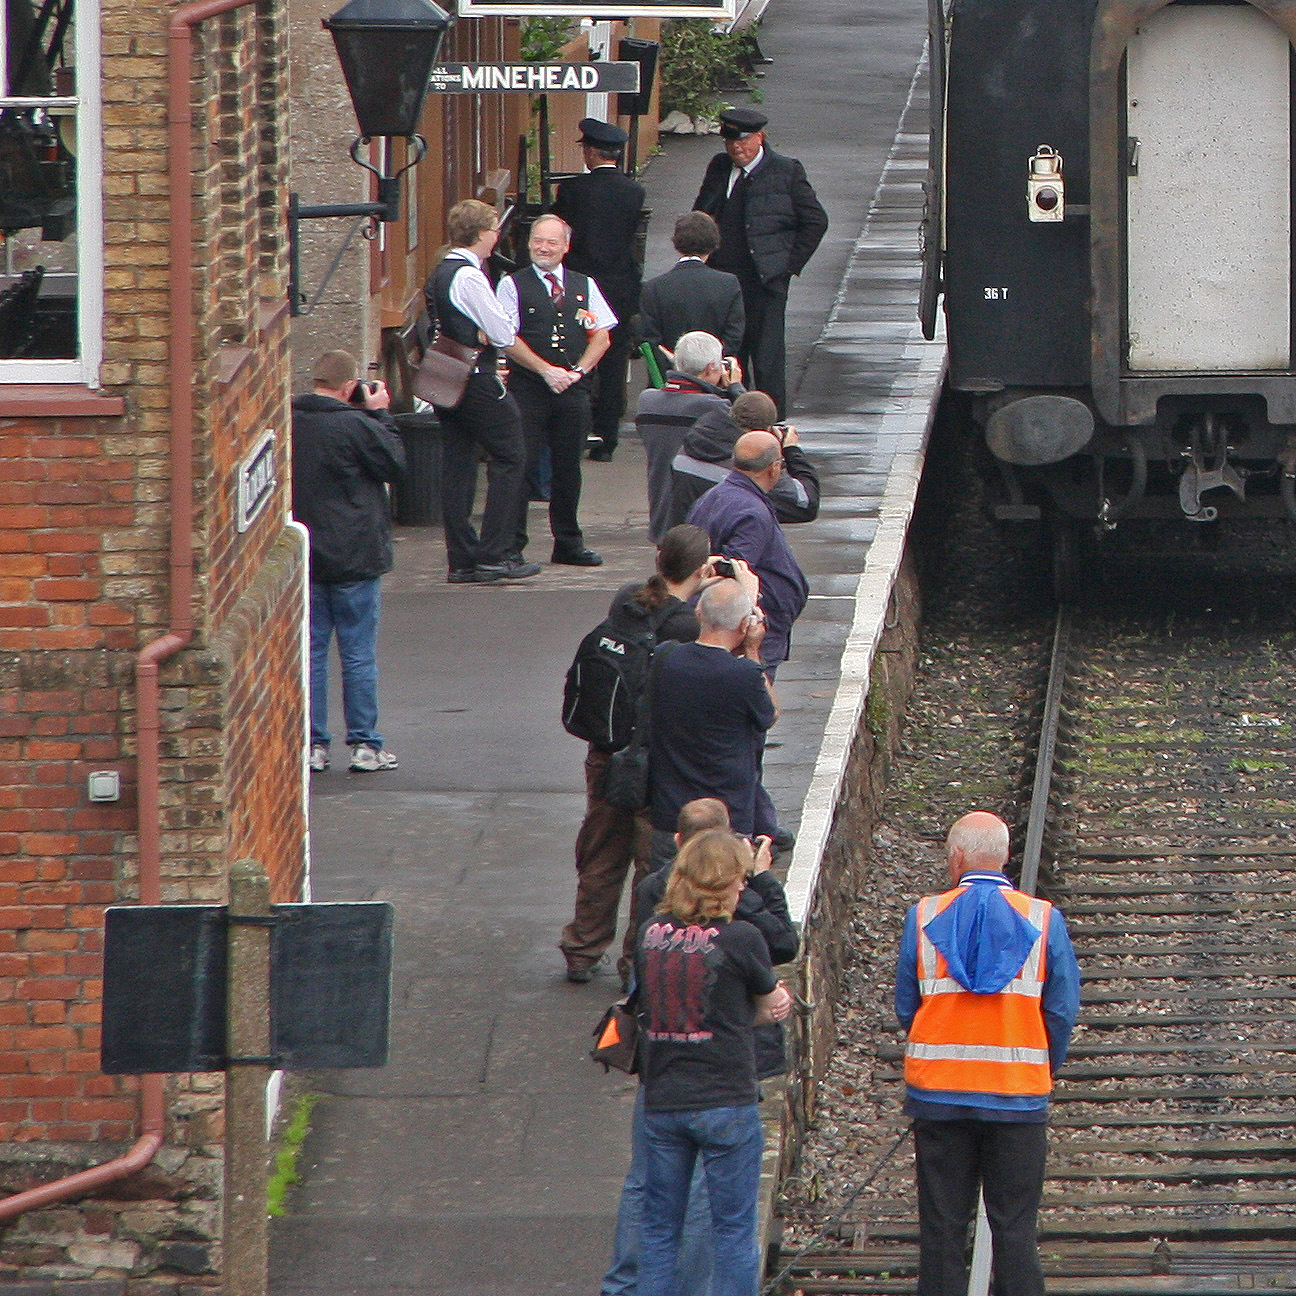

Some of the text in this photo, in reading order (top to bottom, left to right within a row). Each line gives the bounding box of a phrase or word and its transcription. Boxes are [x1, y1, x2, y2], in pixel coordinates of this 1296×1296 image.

[462, 65, 600, 90] MINEHEAD
[984, 287, 999, 300] 36
[599, 636, 626, 655] FILA
[643, 922, 720, 954] AC/DC
